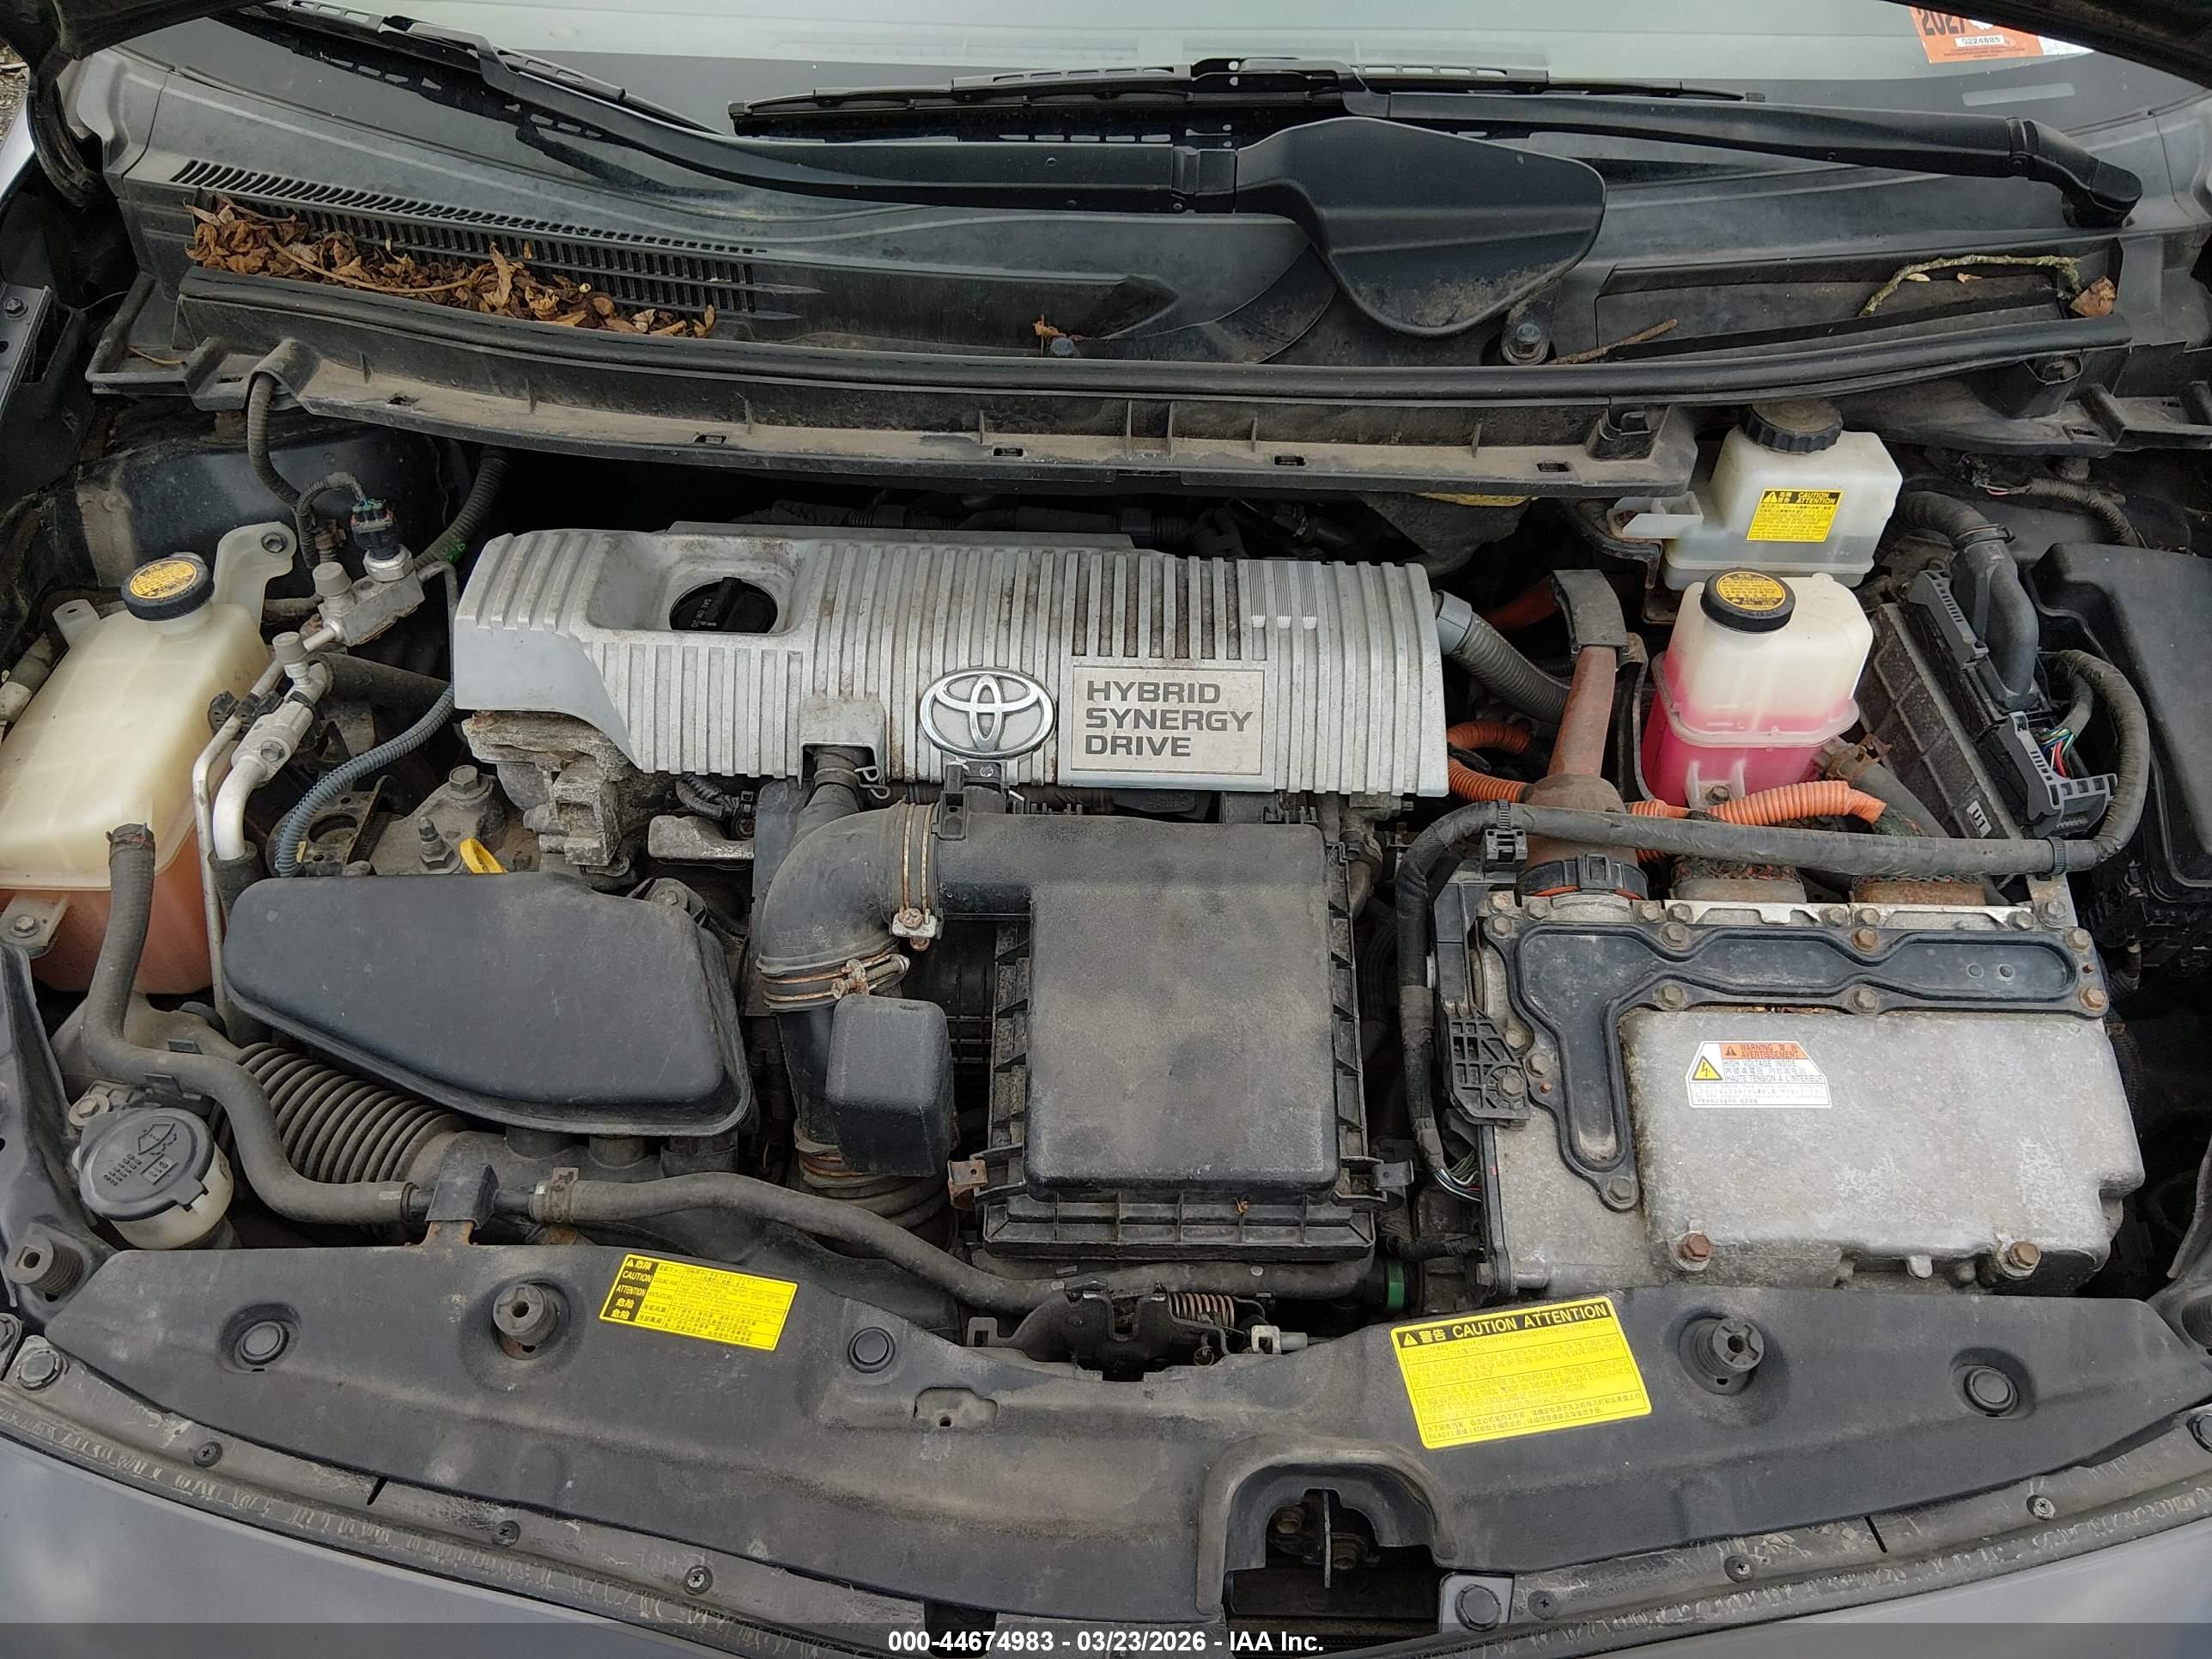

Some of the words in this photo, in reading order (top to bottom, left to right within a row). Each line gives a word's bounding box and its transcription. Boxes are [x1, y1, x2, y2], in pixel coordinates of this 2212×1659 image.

[1086, 680, 1221, 704] HYBRID
[1085, 708, 1254, 732] SYNERGY
[1085, 735, 1192, 757] DRIVE
[622, 1270, 653, 1283] CAUTION
[616, 1284, 647, 1297] ATTENTION
[1419, 1328, 1446, 1343] 警告
[1452, 1317, 1518, 1339] CAUTION
[1523, 1304, 1607, 1328] ATTENTION
